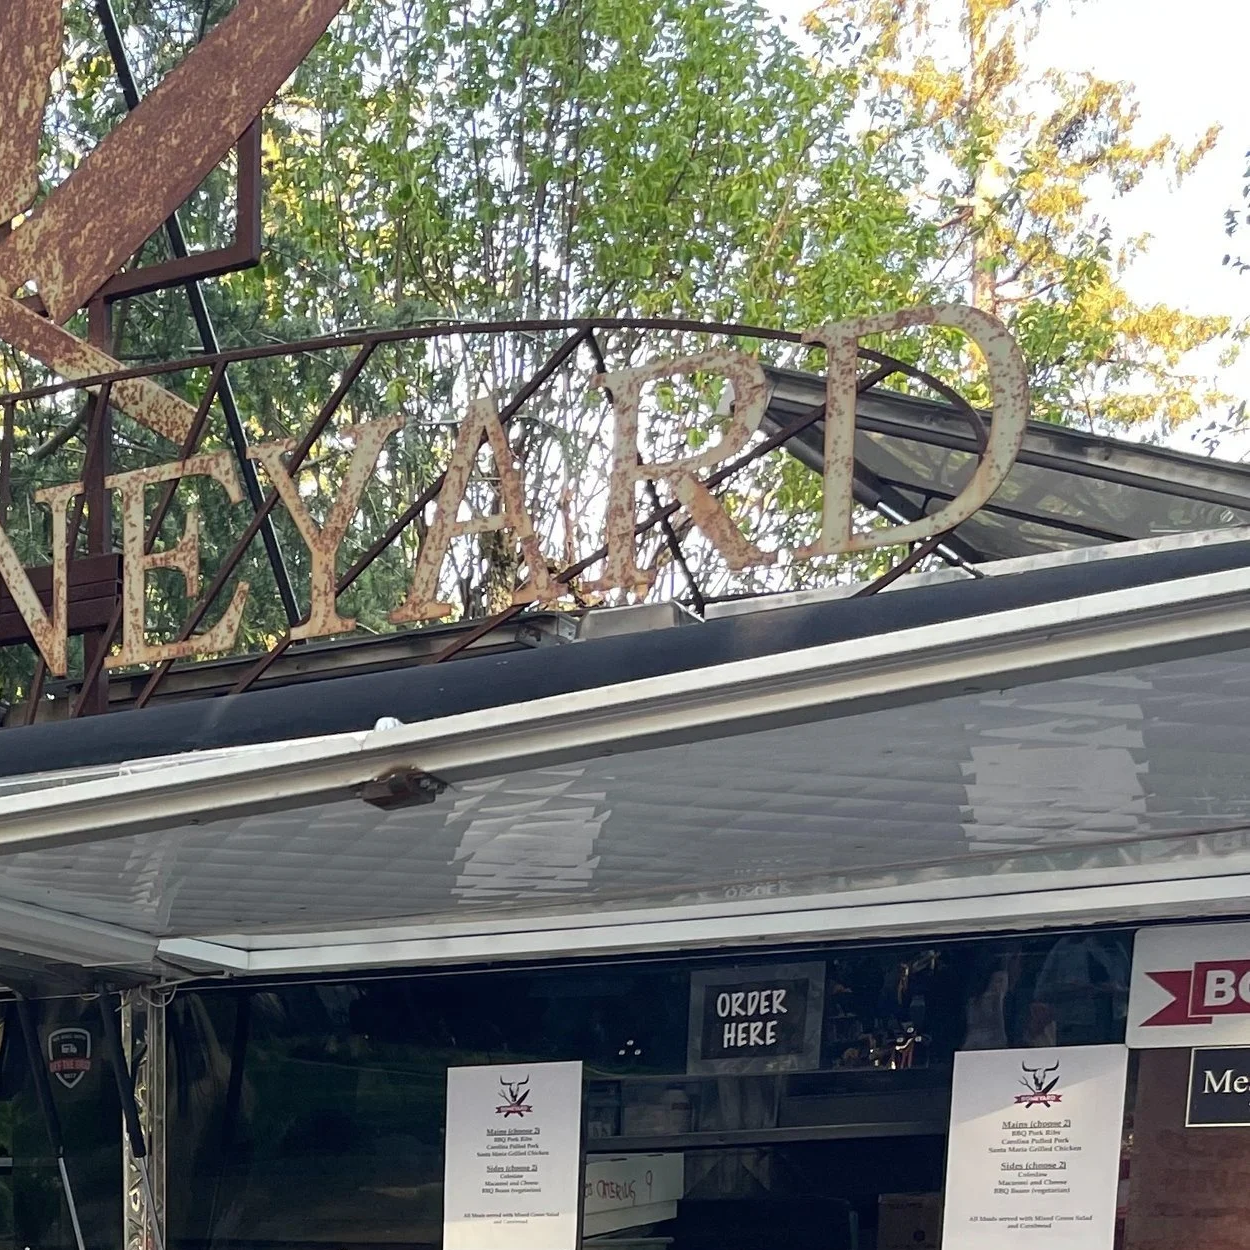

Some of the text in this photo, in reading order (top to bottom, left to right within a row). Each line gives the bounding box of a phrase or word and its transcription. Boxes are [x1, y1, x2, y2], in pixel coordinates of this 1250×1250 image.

[717, 990, 787, 1017] ORDER
[723, 1021, 777, 1048] HERE
[1202, 1069, 1250, 1093] Me
[1002, 1119, 1071, 1129] Mains (choose 2)
[1001, 1161, 1066, 1170] Sides (choose 2)
